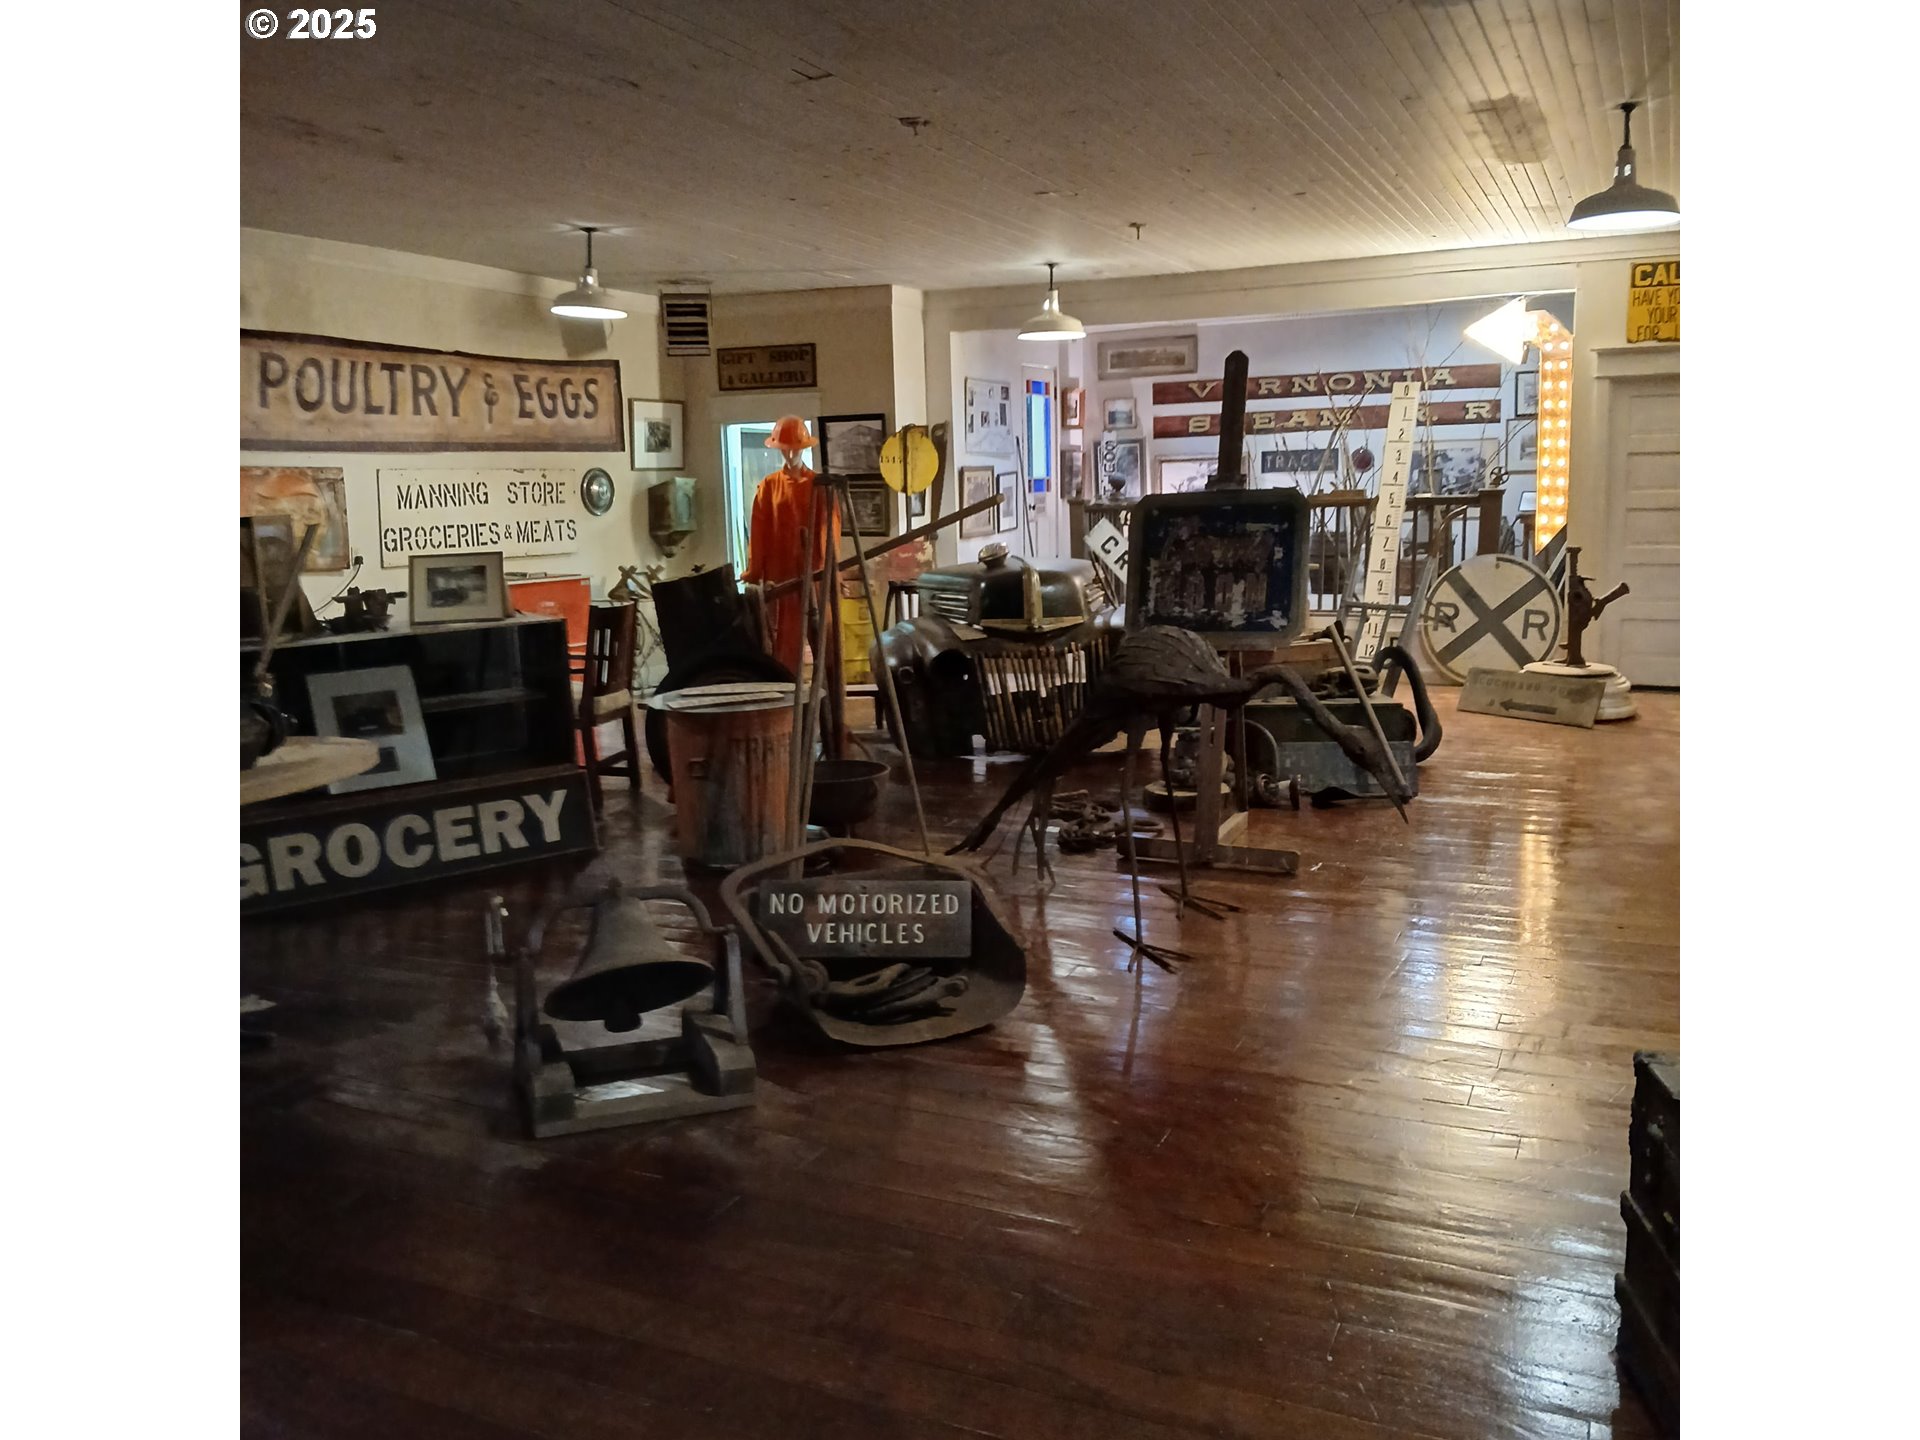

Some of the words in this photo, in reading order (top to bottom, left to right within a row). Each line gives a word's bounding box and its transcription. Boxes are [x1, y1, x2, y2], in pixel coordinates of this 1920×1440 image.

[1633, 288, 1662, 306] HAVE
[1647, 306, 1678, 324] YOUR
[1637, 325, 1660, 341] FOR
[721, 352, 756, 365] GIFT
[769, 349, 809, 362] SHOP
[738, 371, 809, 385] GALLERY
[1188, 367, 1458, 399] VRNONIA
[259, 351, 471, 417] POULTRY
[482, 373, 499, 424] &
[513, 373, 600, 419] EGGS
[1403, 384, 1410, 397] 0
[1188, 408, 1352, 433] SEAM
[1398, 428, 1405, 440] 2
[1395, 449, 1402, 462] 3
[1392, 471, 1399, 484] 4
[396, 482, 489, 510] MANNING
[507, 482, 566, 504] STORE
[1388, 492, 1395, 505] 5
[1385, 514, 1392, 527] 6
[383, 522, 501, 553] GROCERIES
[504, 523, 513, 540] &
[516, 519, 577, 544] MEATS
[1382, 536, 1390, 549] 7
[1367, 622, 1379, 635] 11
[1432, 601, 1460, 634] R
[1521, 608, 1550, 642] R
[1364, 643, 1375, 657] 12
[769, 893, 804, 914] NO
[817, 893, 960, 915] MOTORIZED
[806, 923, 926, 944] VEHICLES
